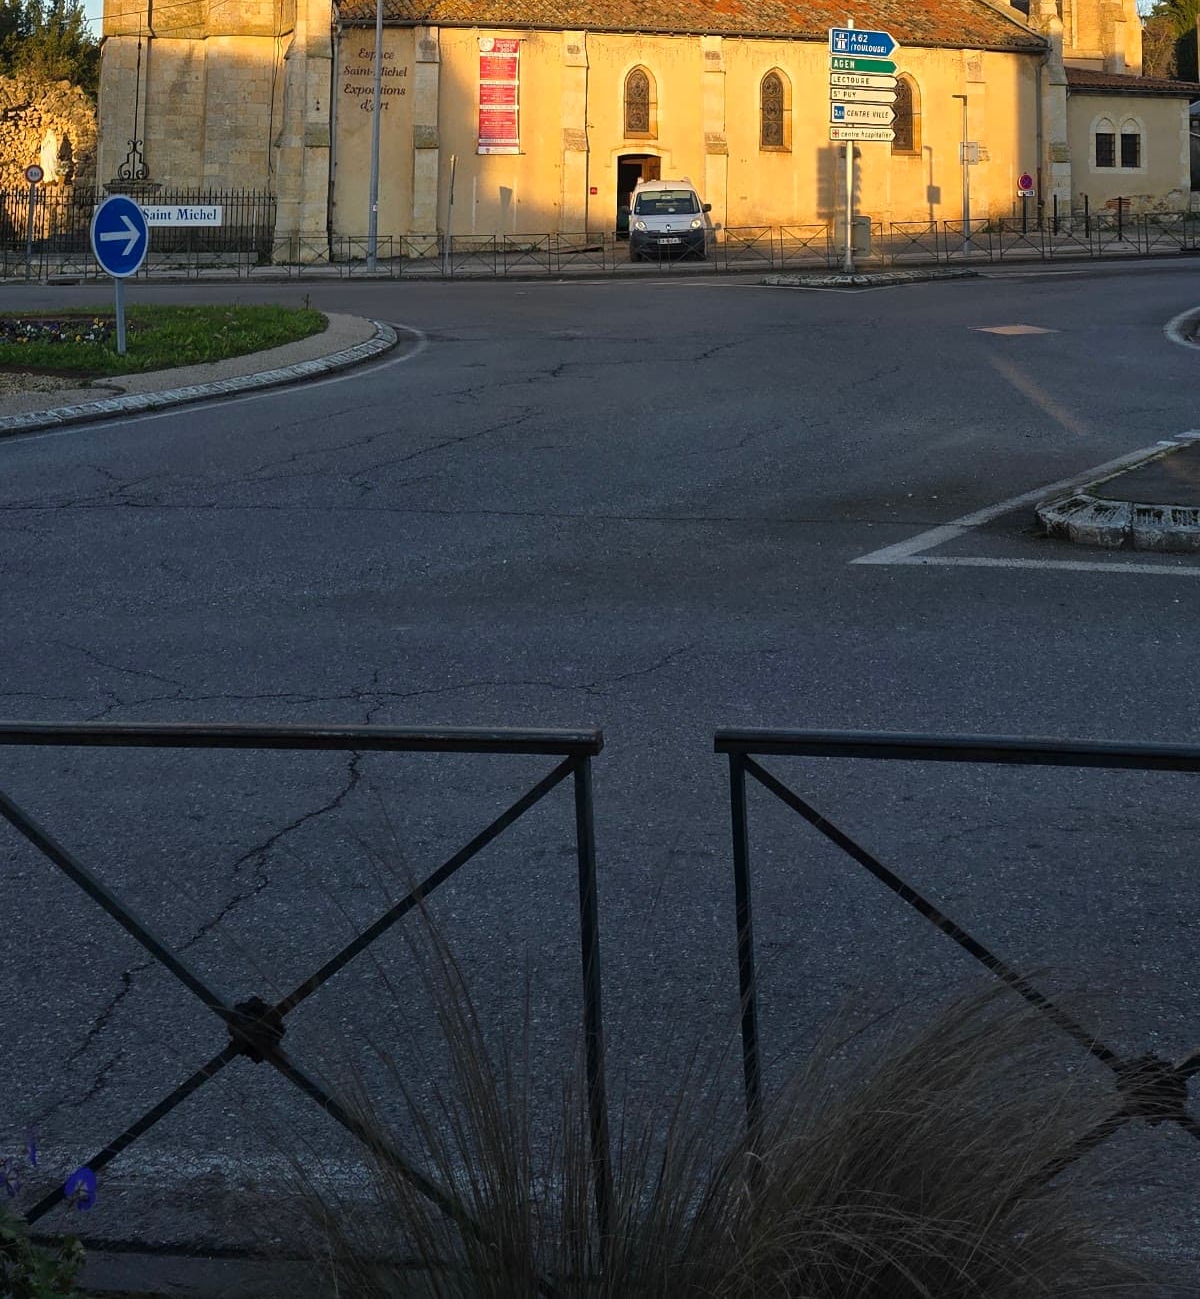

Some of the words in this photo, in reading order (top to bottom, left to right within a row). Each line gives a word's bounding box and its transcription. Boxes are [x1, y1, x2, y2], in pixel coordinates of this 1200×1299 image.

[850, 34, 857, 43] A
[857, 34, 869, 43] 62
[358, 47, 395, 61] Espce
[850, 43, 887, 54] (TOULOUSE)
[833, 59, 856, 69] AGEN
[343, 65, 408, 78] Saint-ichel
[833, 75, 870, 85] LECTOURE
[343, 83, 406, 98] Expotions
[846, 109, 870, 118] CENTRE
[872, 110, 889, 119] VILLE
[143, 208, 171, 221] Saint
[176, 208, 217, 221] Michel
